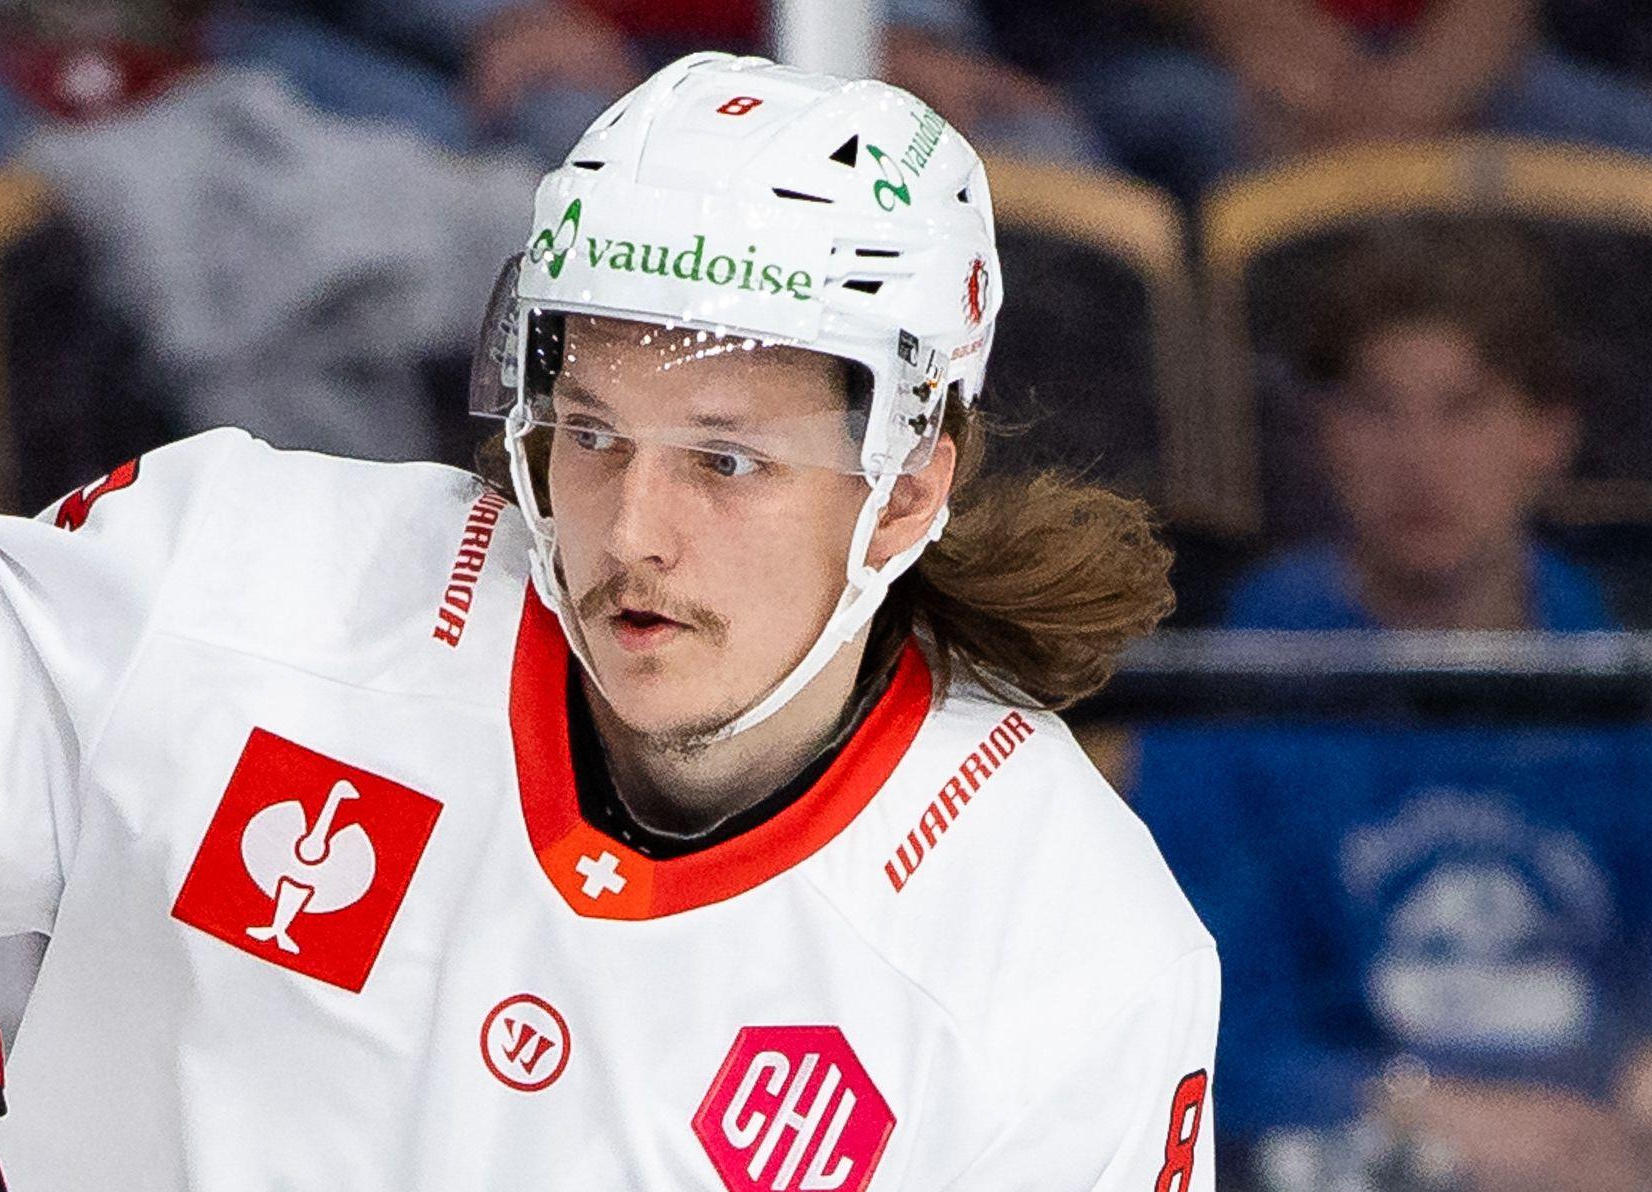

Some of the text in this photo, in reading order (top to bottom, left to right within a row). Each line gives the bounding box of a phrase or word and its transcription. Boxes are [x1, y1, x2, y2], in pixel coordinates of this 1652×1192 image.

[716, 96, 763, 116] 8
[585, 233, 814, 302] vaudoise
[432, 488, 509, 648] WARRIOR
[883, 710, 1035, 894] WARRIOR
[722, 1050, 858, 1192] CHL
